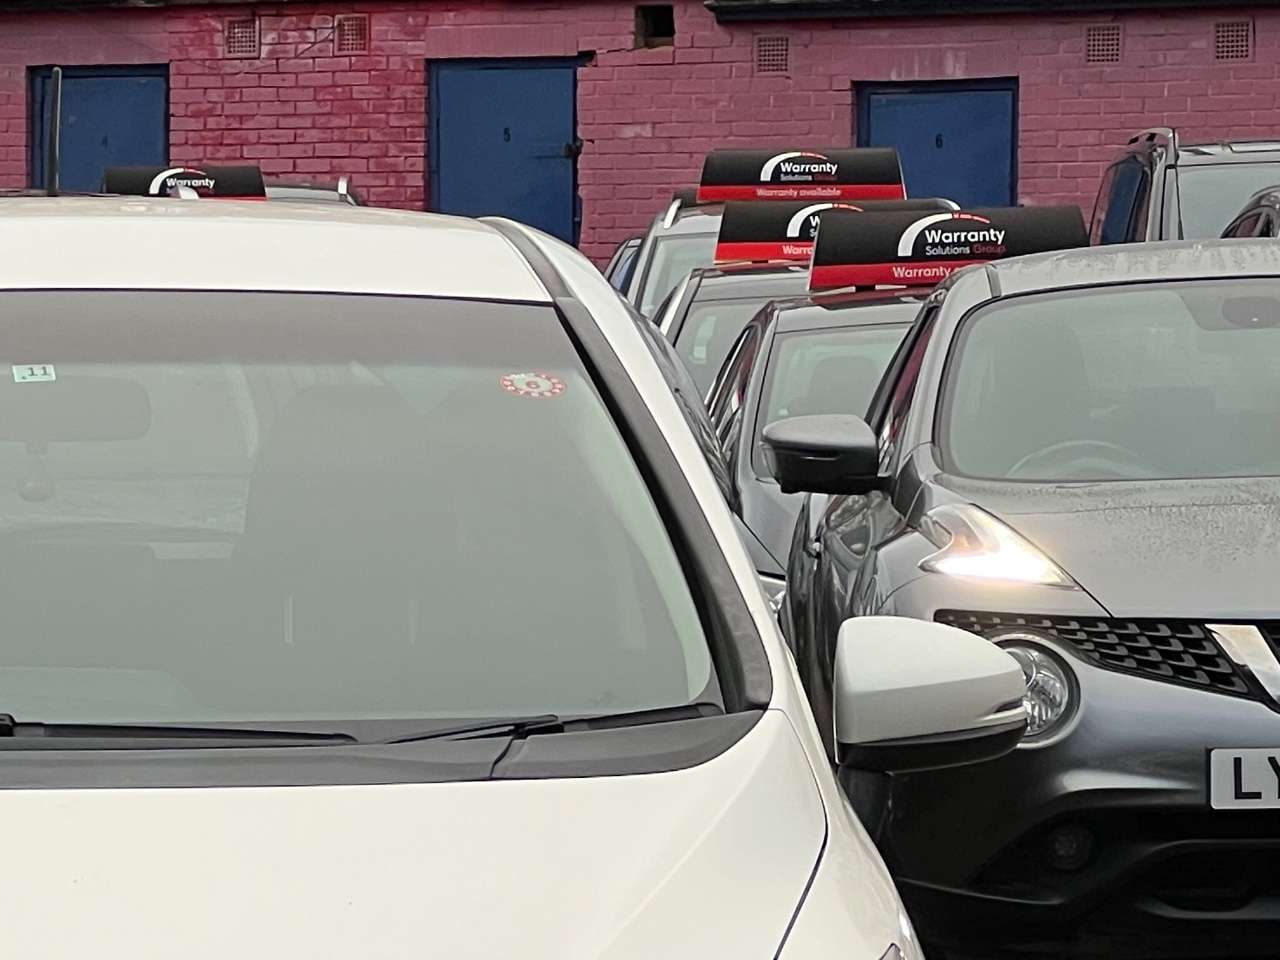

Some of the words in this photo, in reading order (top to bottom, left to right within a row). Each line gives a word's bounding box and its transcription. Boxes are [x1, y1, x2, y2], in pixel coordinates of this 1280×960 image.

[935, 133, 943, 149] 6
[780, 162, 838, 175] Warranty
[166, 178, 216, 189] Warranty
[756, 187, 798, 198] Warranty
[924, 228, 1005, 245] Warranty
[782, 245, 815, 255] Warra
[925, 245, 971, 256] Solutions
[892, 266, 951, 279] Warranty
